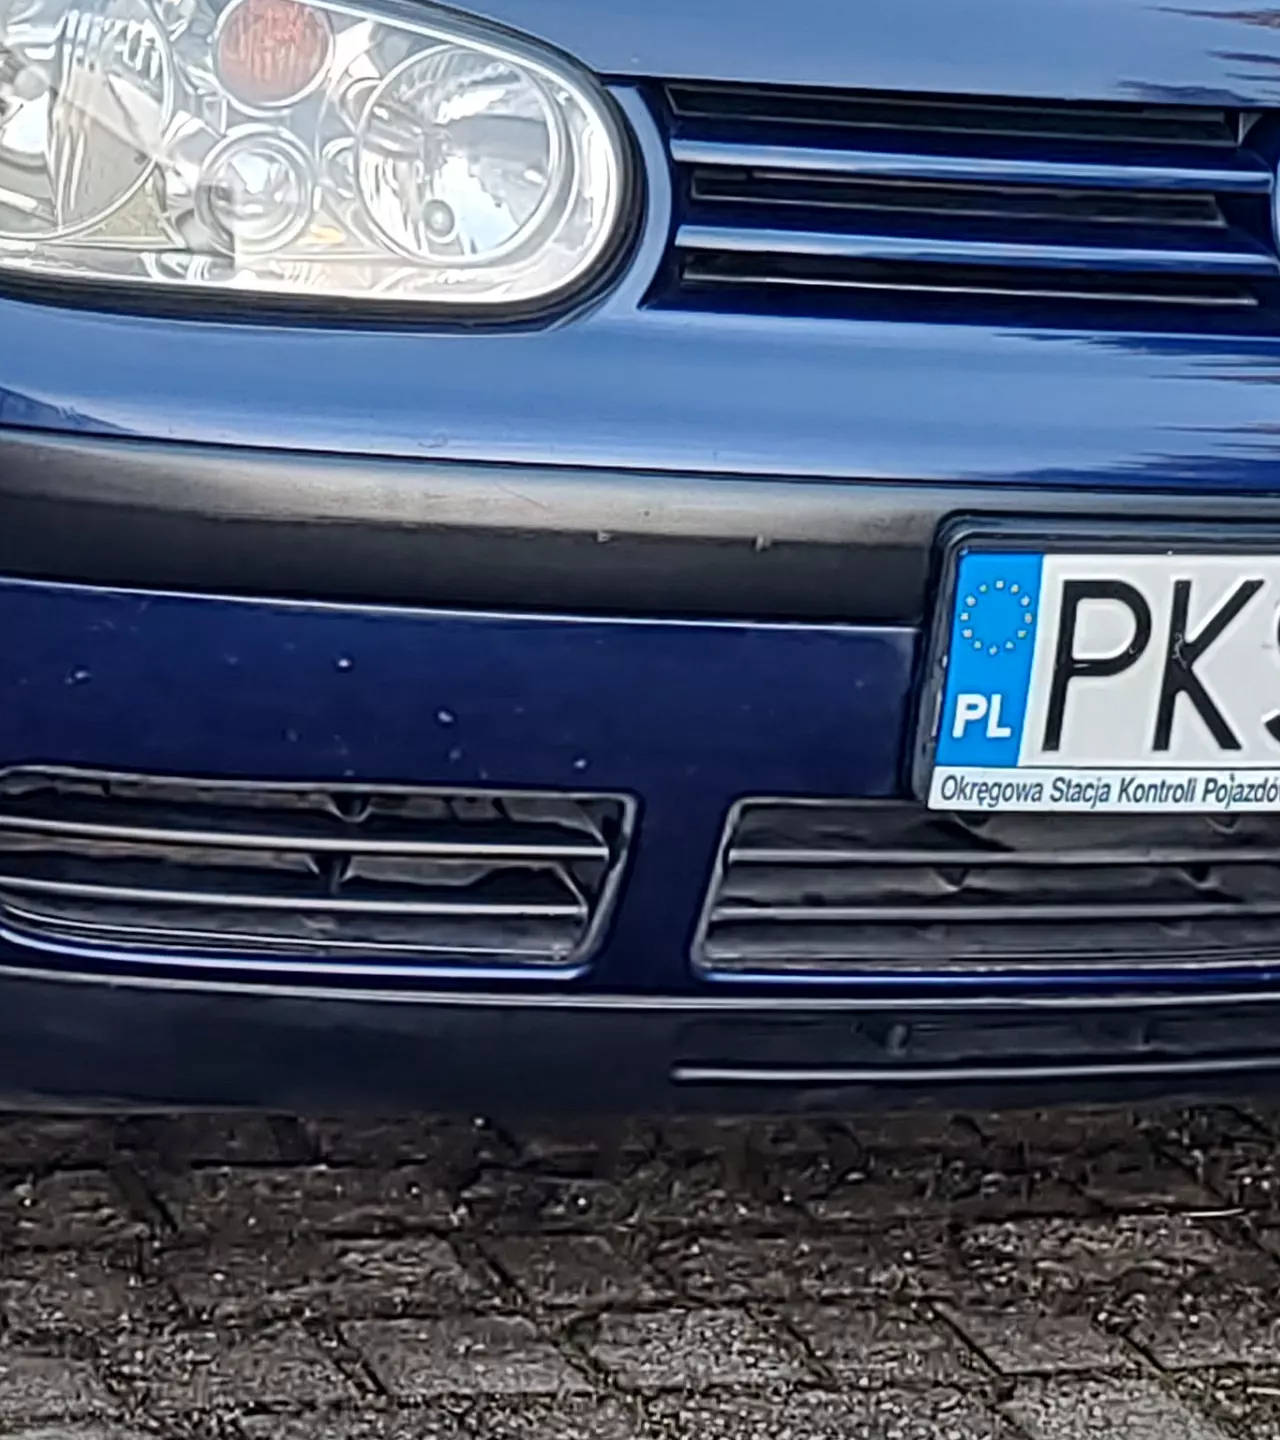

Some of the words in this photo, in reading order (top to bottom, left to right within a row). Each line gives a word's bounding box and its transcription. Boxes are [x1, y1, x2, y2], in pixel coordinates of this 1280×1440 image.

[952, 693, 1011, 739] PL
[940, 774, 1043, 808] Okręgowa
[1049, 776, 1110, 808] Stacja
[1117, 776, 1195, 803] Kontroli
